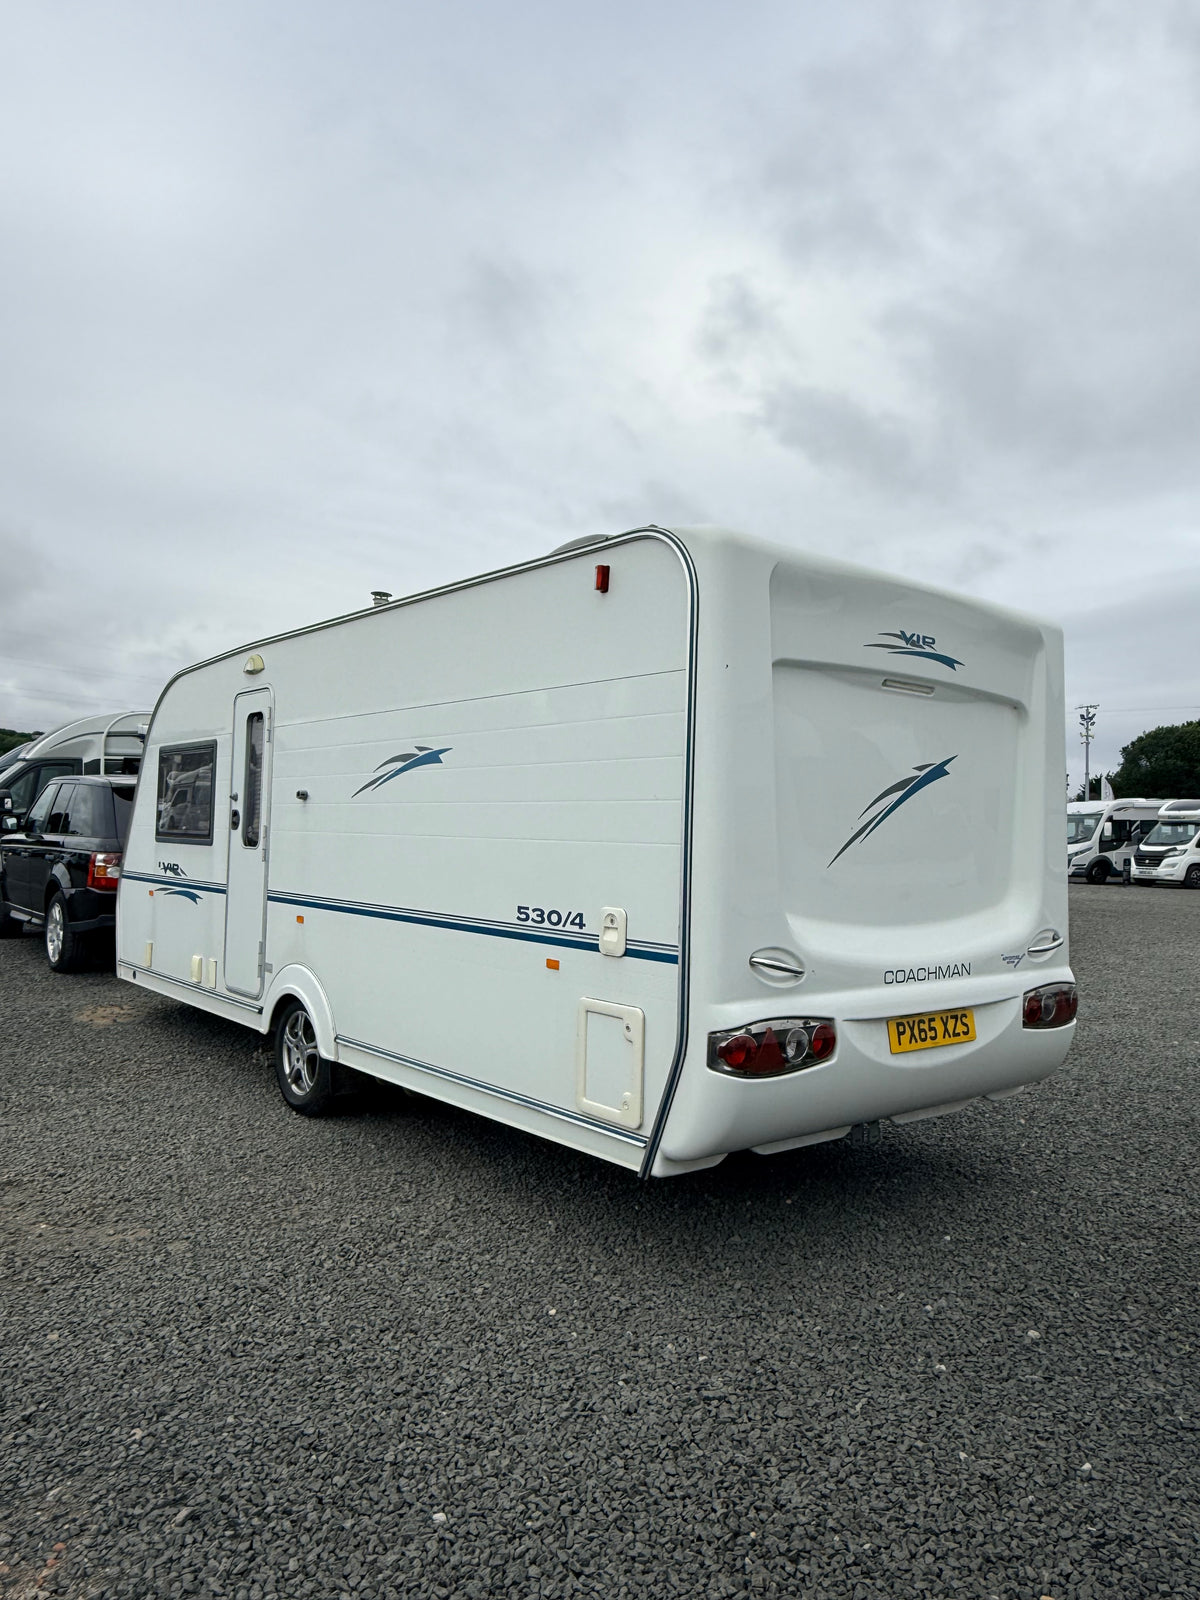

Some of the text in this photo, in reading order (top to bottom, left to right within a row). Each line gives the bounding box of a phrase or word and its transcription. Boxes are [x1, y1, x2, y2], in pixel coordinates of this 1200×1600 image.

[900, 630, 936, 646] VIP
[516, 905, 586, 930] 530/4
[883, 962, 971, 985] COACHMAN
[895, 1013, 970, 1046] PX65 XZS
